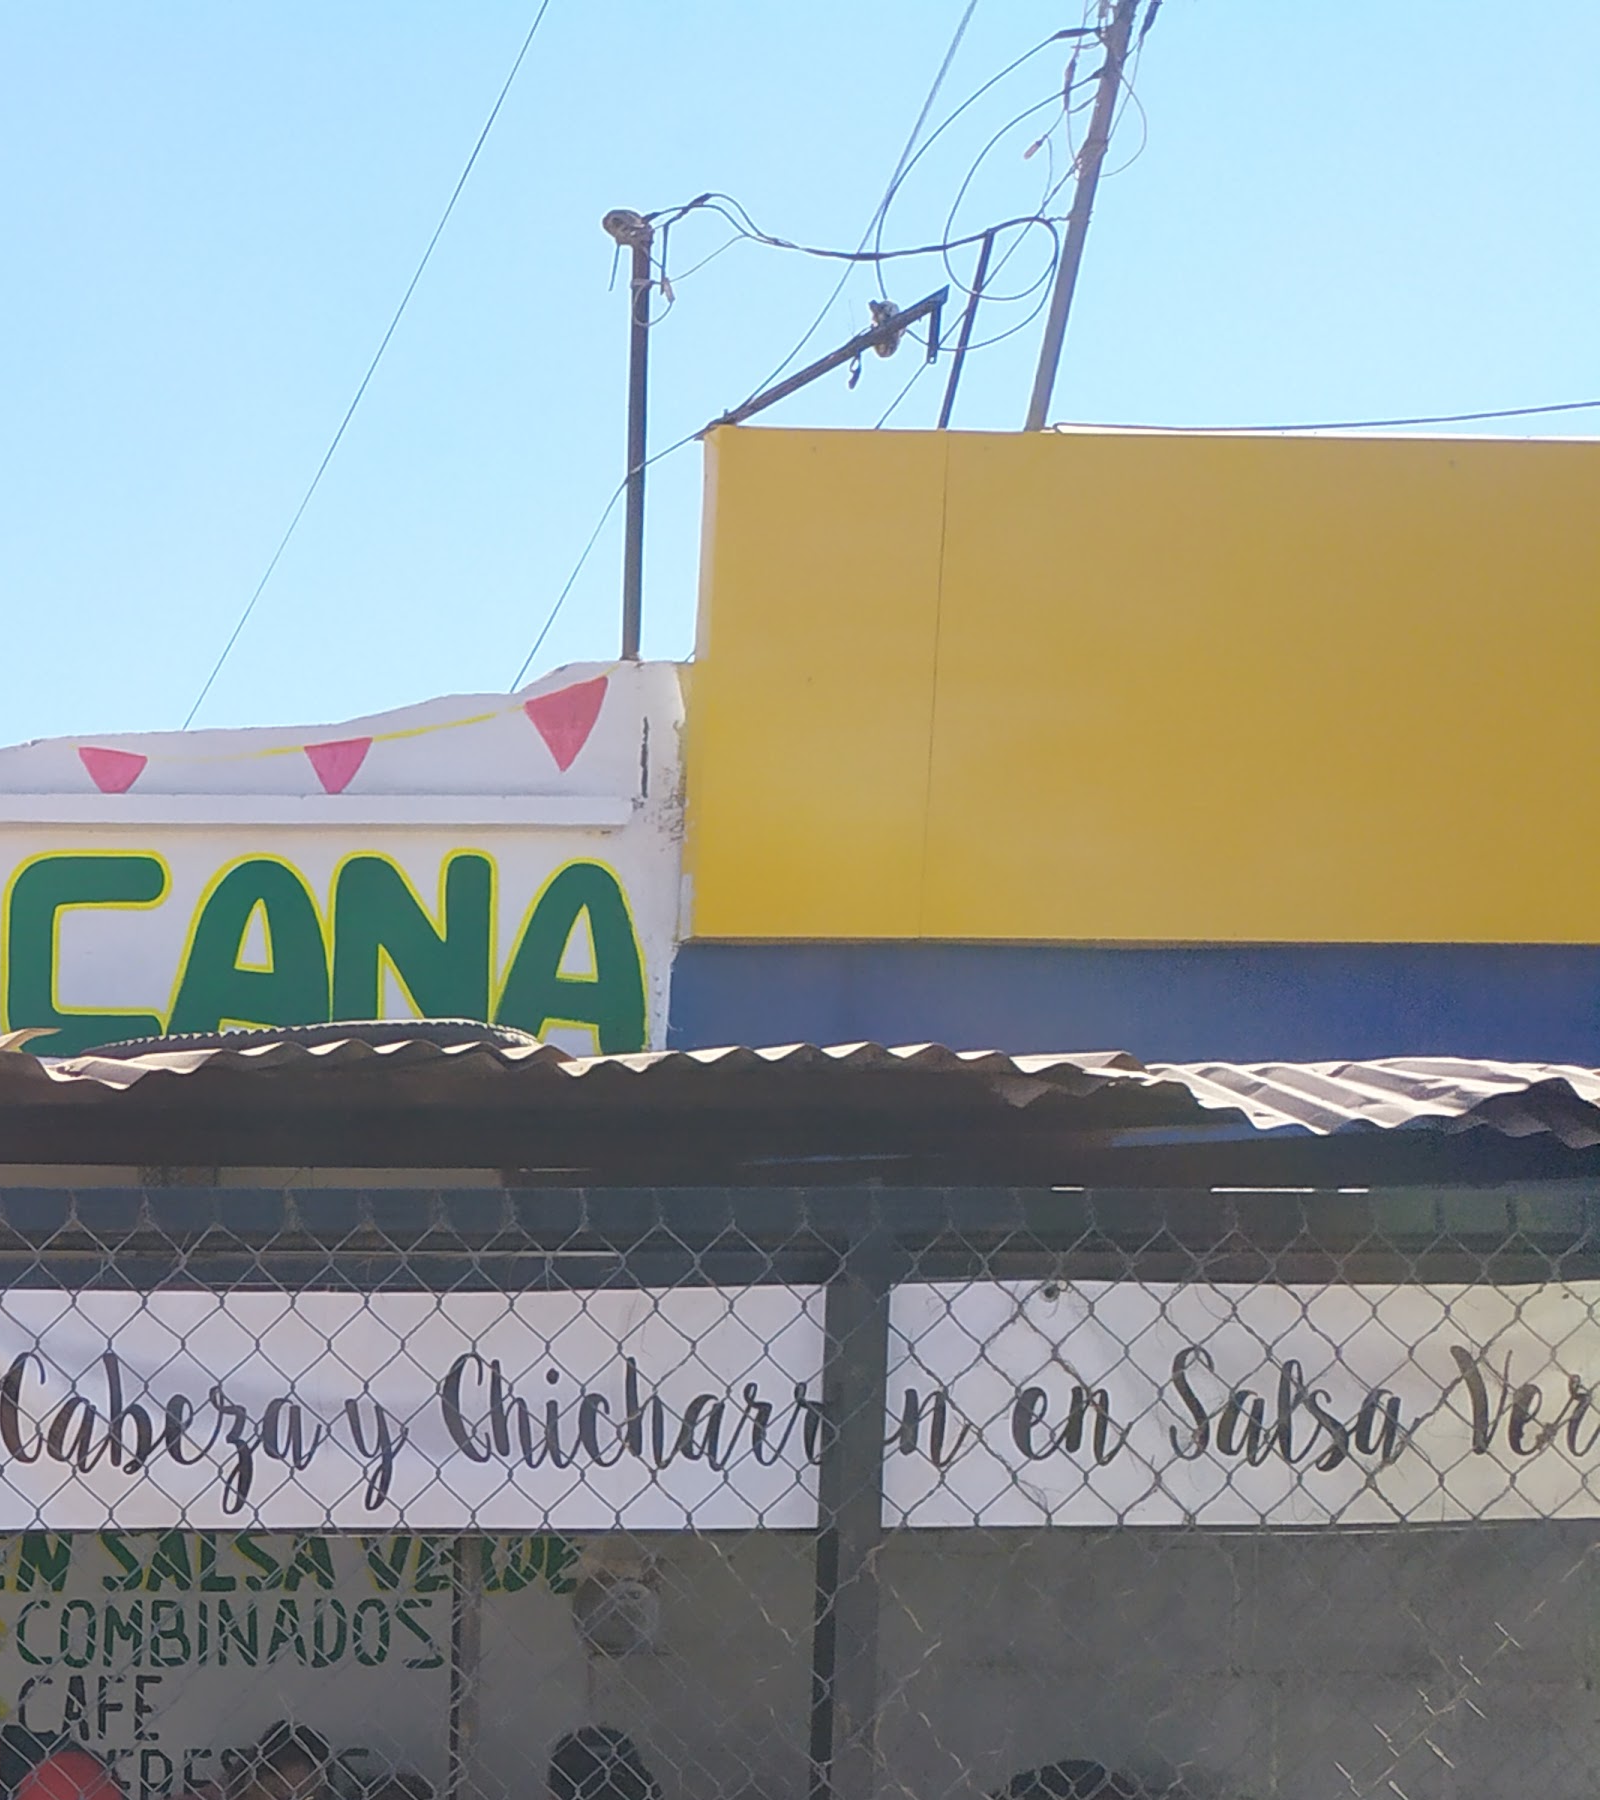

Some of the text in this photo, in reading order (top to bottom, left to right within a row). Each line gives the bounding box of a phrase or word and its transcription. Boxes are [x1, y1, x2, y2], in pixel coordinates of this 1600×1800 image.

[345, 1397, 407, 1511] y
[441, 1352, 974, 1469] Chicharrn
[1011, 1385, 1133, 1467] en
[1169, 1346, 1420, 1473] Salsa
[1449, 1344, 1600, 1458] Ver
[100, 1533, 336, 1594] SALSA
[15, 1598, 447, 1669] COMBINADOS
[17, 1674, 163, 1742] CAFE
